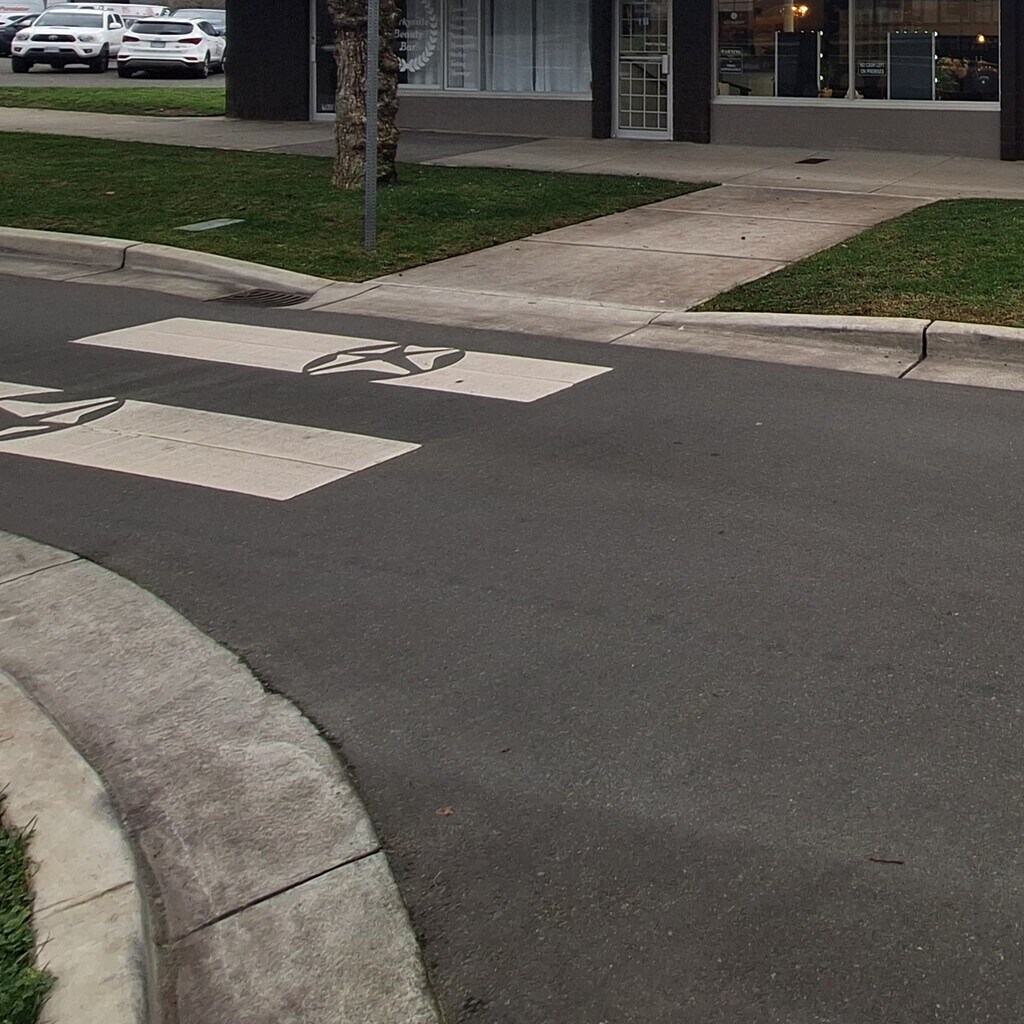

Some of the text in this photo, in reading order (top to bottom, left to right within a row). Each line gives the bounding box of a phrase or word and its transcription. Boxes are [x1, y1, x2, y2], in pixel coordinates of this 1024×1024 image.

[399, 17, 430, 27] rksville
[394, 28, 424, 40] Beauty
[398, 41, 416, 51] Bar
